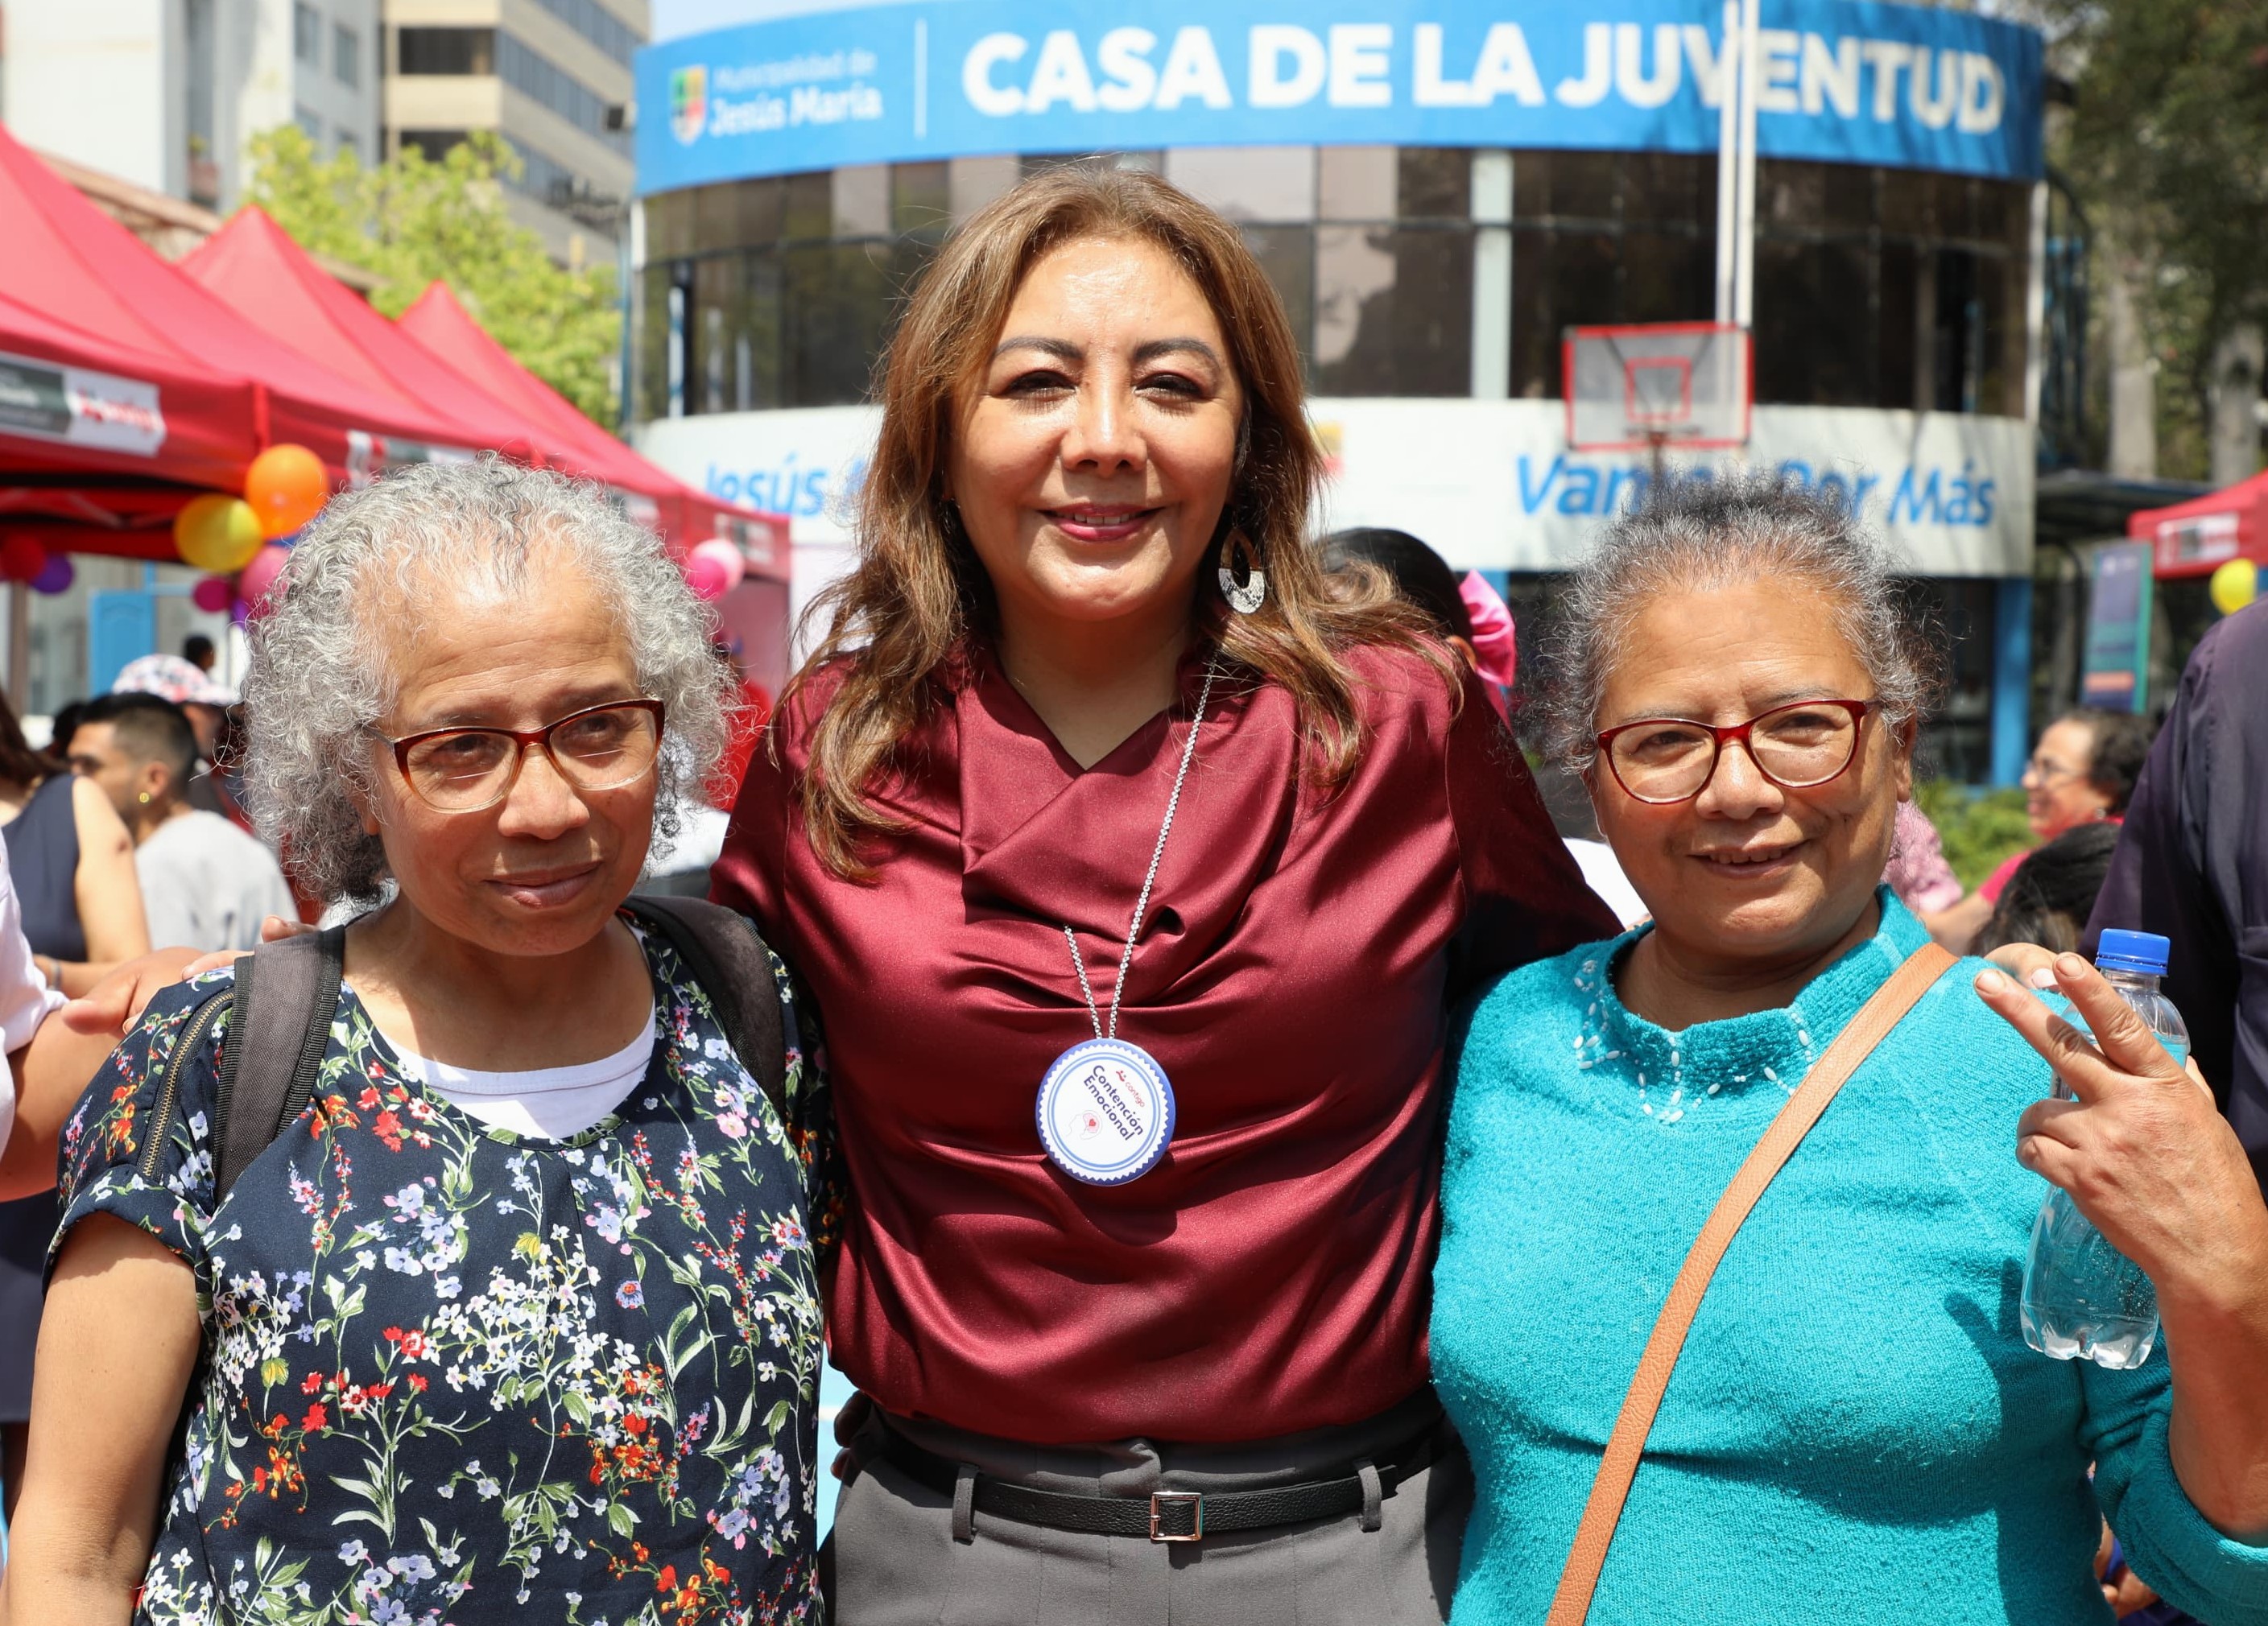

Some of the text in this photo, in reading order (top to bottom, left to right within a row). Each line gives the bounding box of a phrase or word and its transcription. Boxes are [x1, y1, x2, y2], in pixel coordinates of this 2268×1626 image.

[709, 80, 882, 137] Jesús María
[962, 23, 2007, 134] CASA DE LA JUVENTUD
[1887, 457, 1995, 526] Más
[1083, 1075, 1135, 1141] Emocional
[1093, 1065, 1144, 1136] Contención
[1125, 1082, 1145, 1108] contigo
